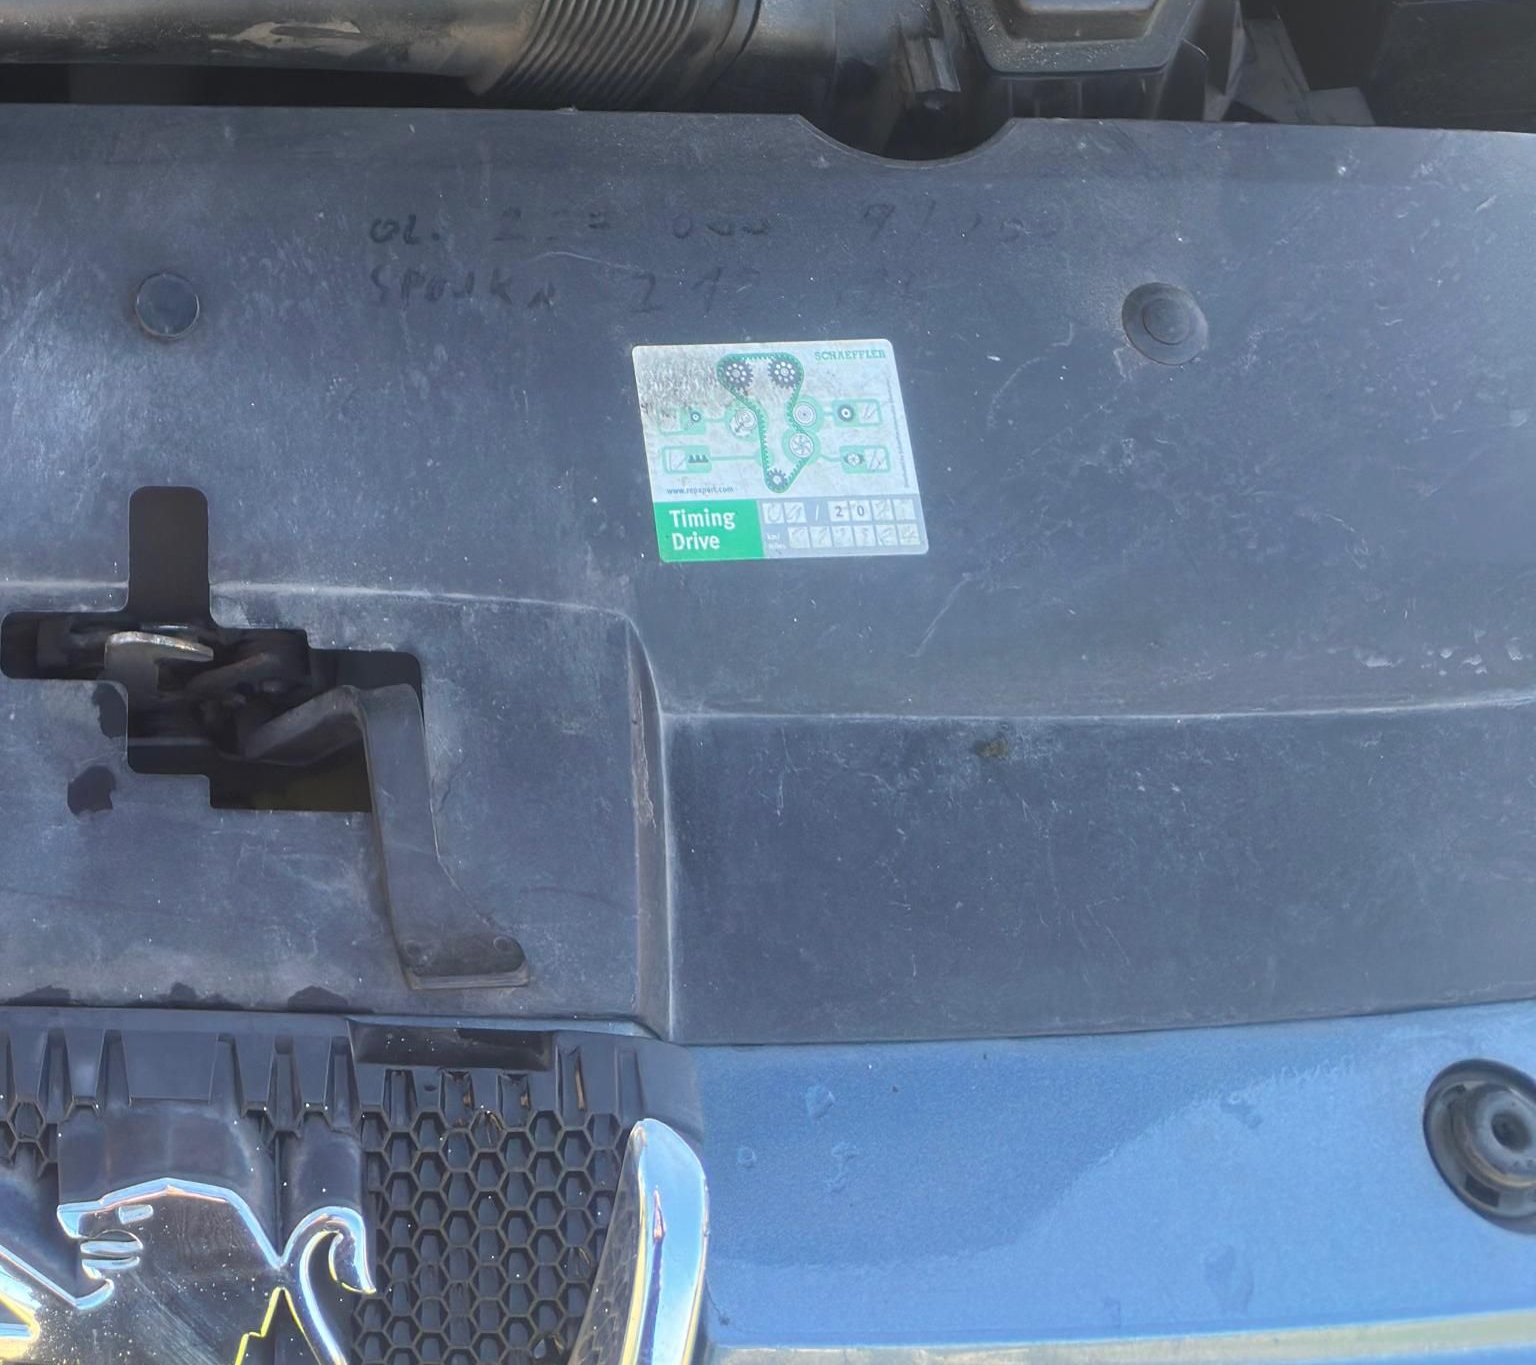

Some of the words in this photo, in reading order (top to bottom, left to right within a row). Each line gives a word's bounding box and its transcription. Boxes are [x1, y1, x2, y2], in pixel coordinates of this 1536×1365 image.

[814, 349, 886, 361] SCHAEFFLER
[669, 507, 736, 530] Timing
[671, 531, 720, 550] Drive
